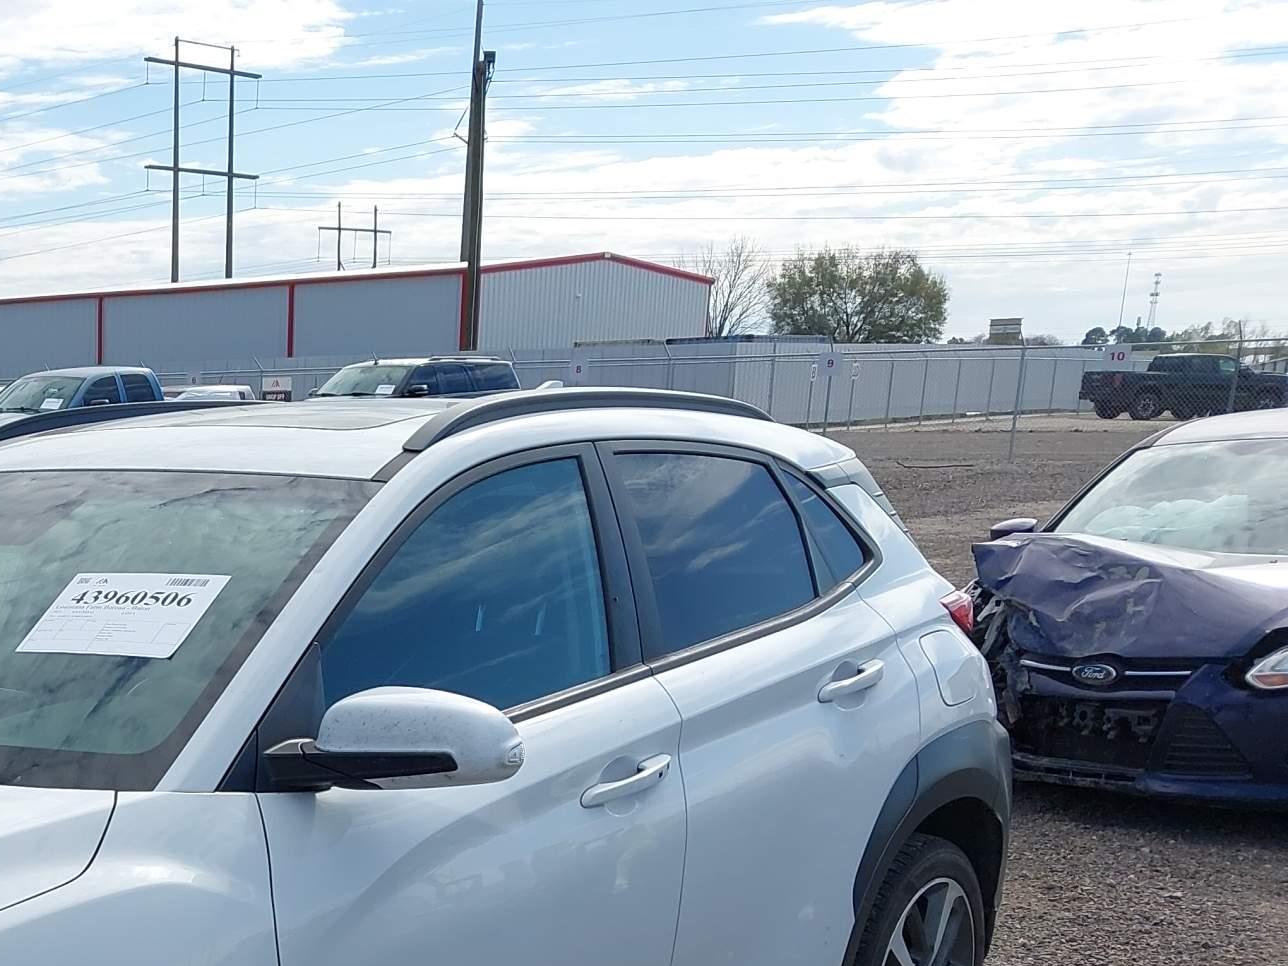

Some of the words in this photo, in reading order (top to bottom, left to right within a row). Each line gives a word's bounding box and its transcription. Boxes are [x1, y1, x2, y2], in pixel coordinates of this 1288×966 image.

[1109, 351, 1125, 361] 10
[827, 359, 834, 368] 9
[71, 590, 196, 607] 43960506
[1081, 667, 1106, 679] Ford
